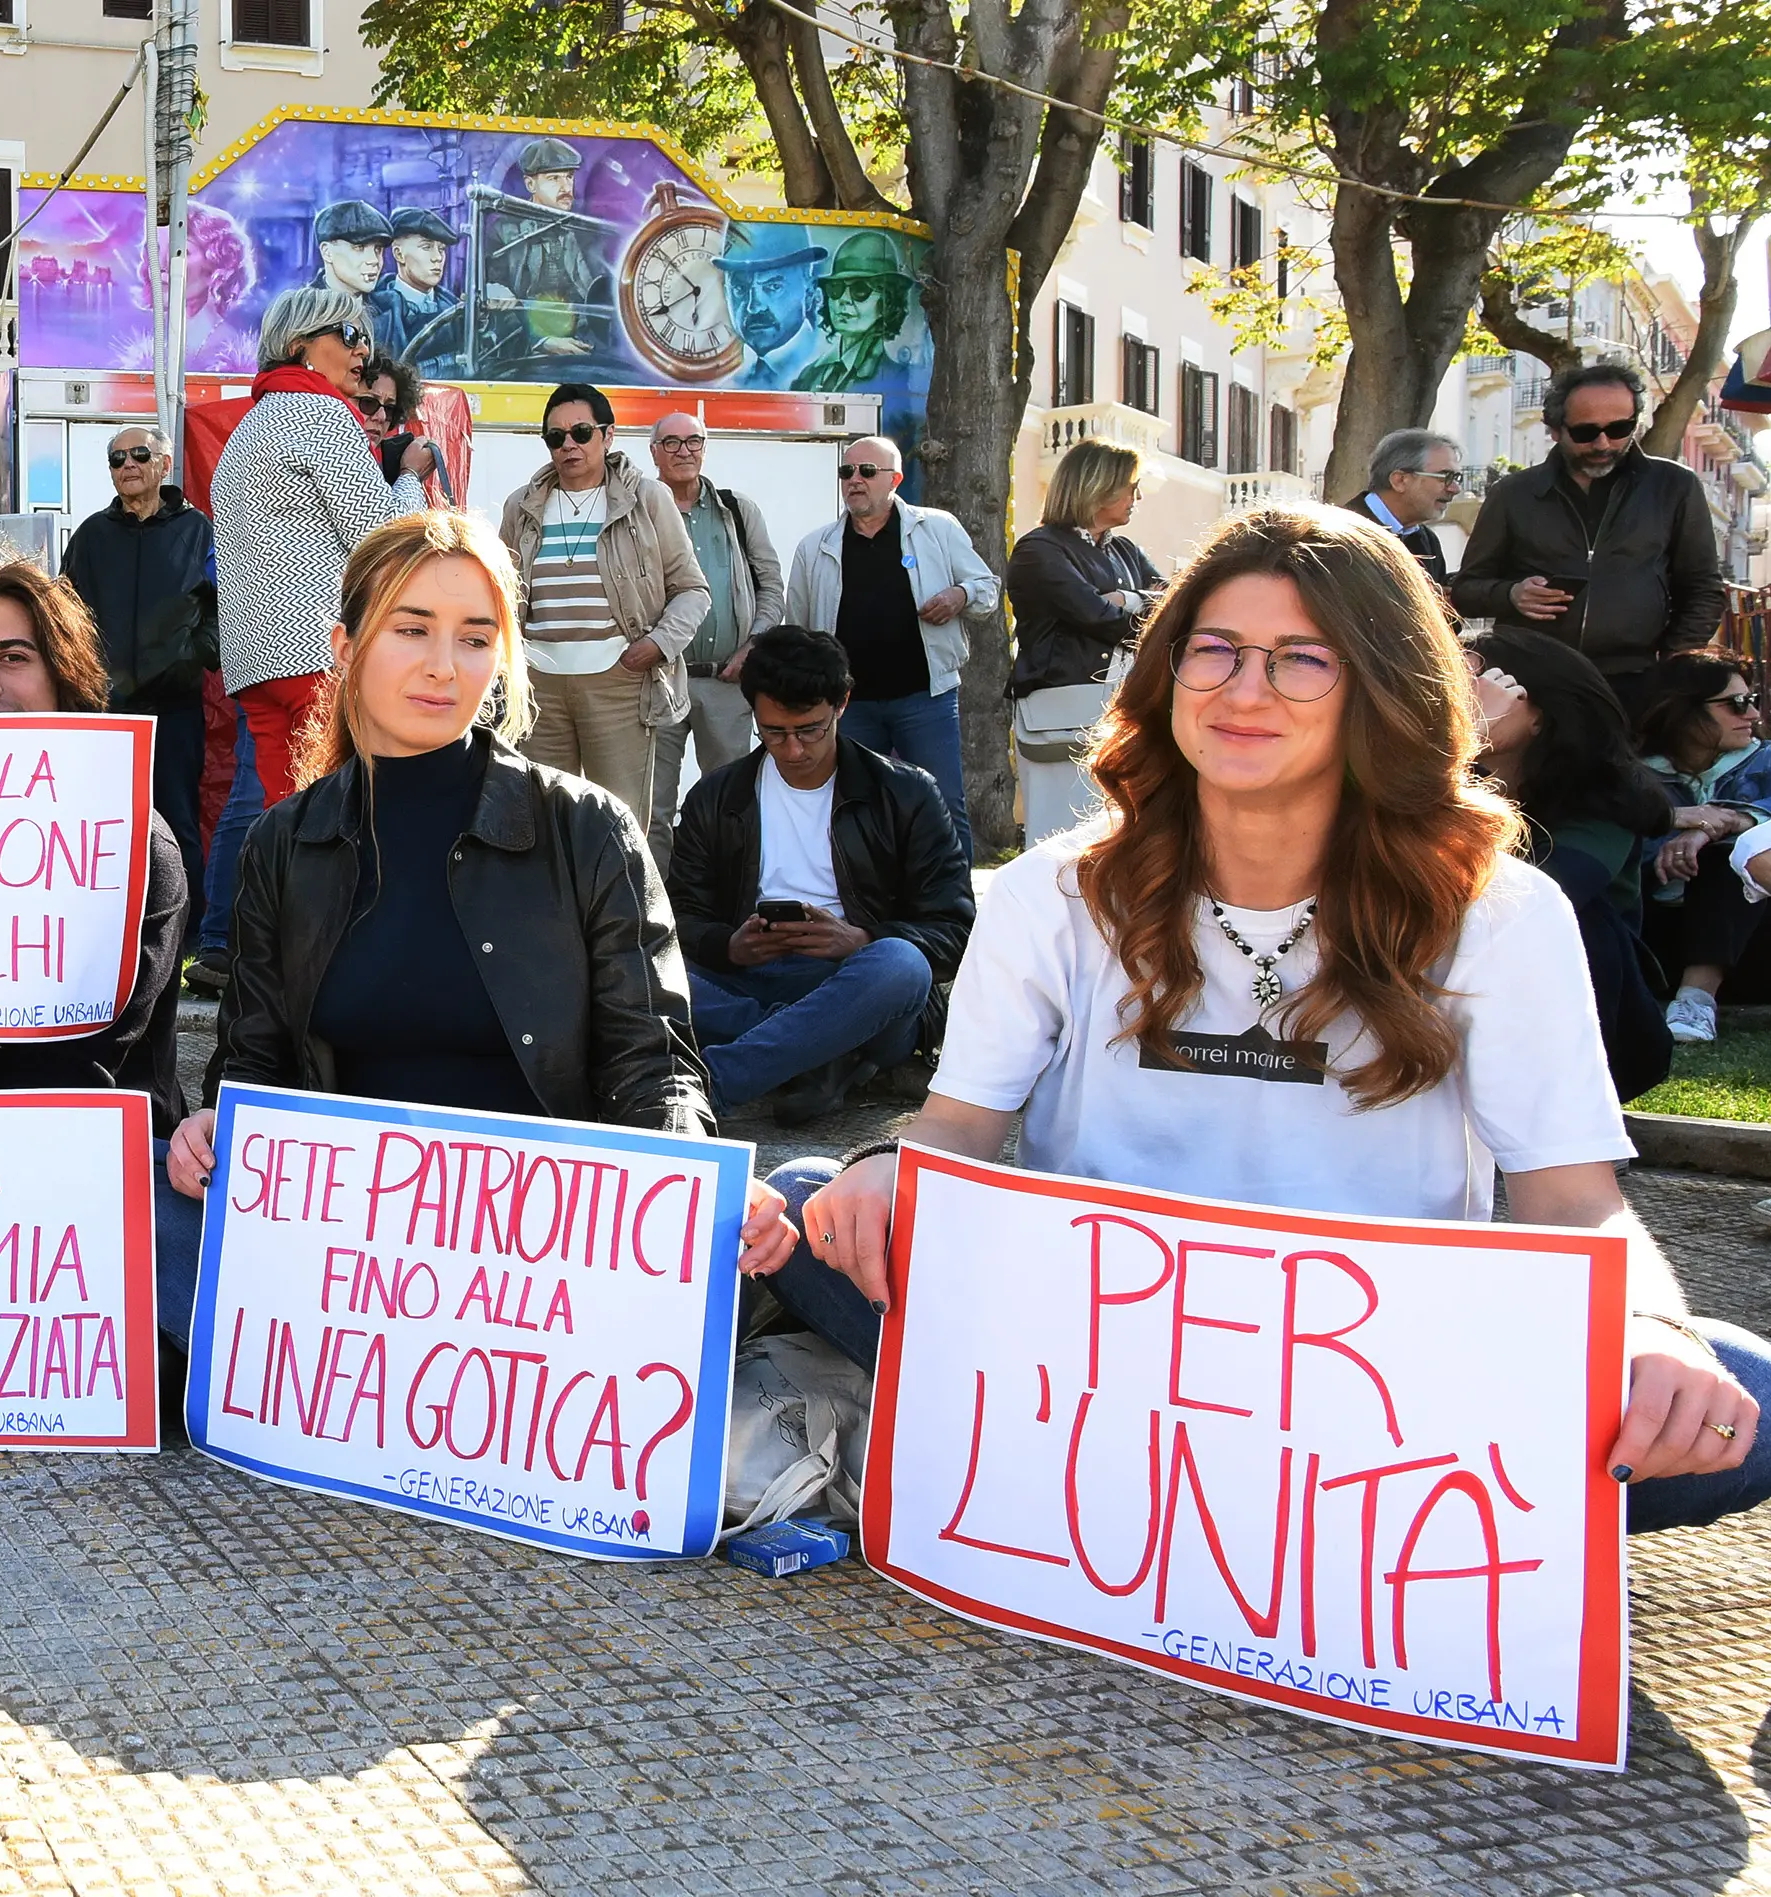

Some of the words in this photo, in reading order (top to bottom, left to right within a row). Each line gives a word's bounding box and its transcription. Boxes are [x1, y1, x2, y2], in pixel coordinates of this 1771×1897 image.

[53, 1001, 115, 1023] URBANA
[231, 1132, 357, 1223] SIETE
[364, 1131, 703, 1284] PATRIOTTICI
[321, 1246, 441, 1320] FINO
[454, 1265, 575, 1335] ALLA
[1070, 1213, 1405, 1447] PER
[221, 1306, 386, 1449] LINEA
[404, 1341, 696, 1534] GOTICA?
[561, 1508, 651, 1543] URBANA
[938, 1363, 1545, 1704] L'UNITÀ
[1412, 1688, 1566, 1735] URBANA
